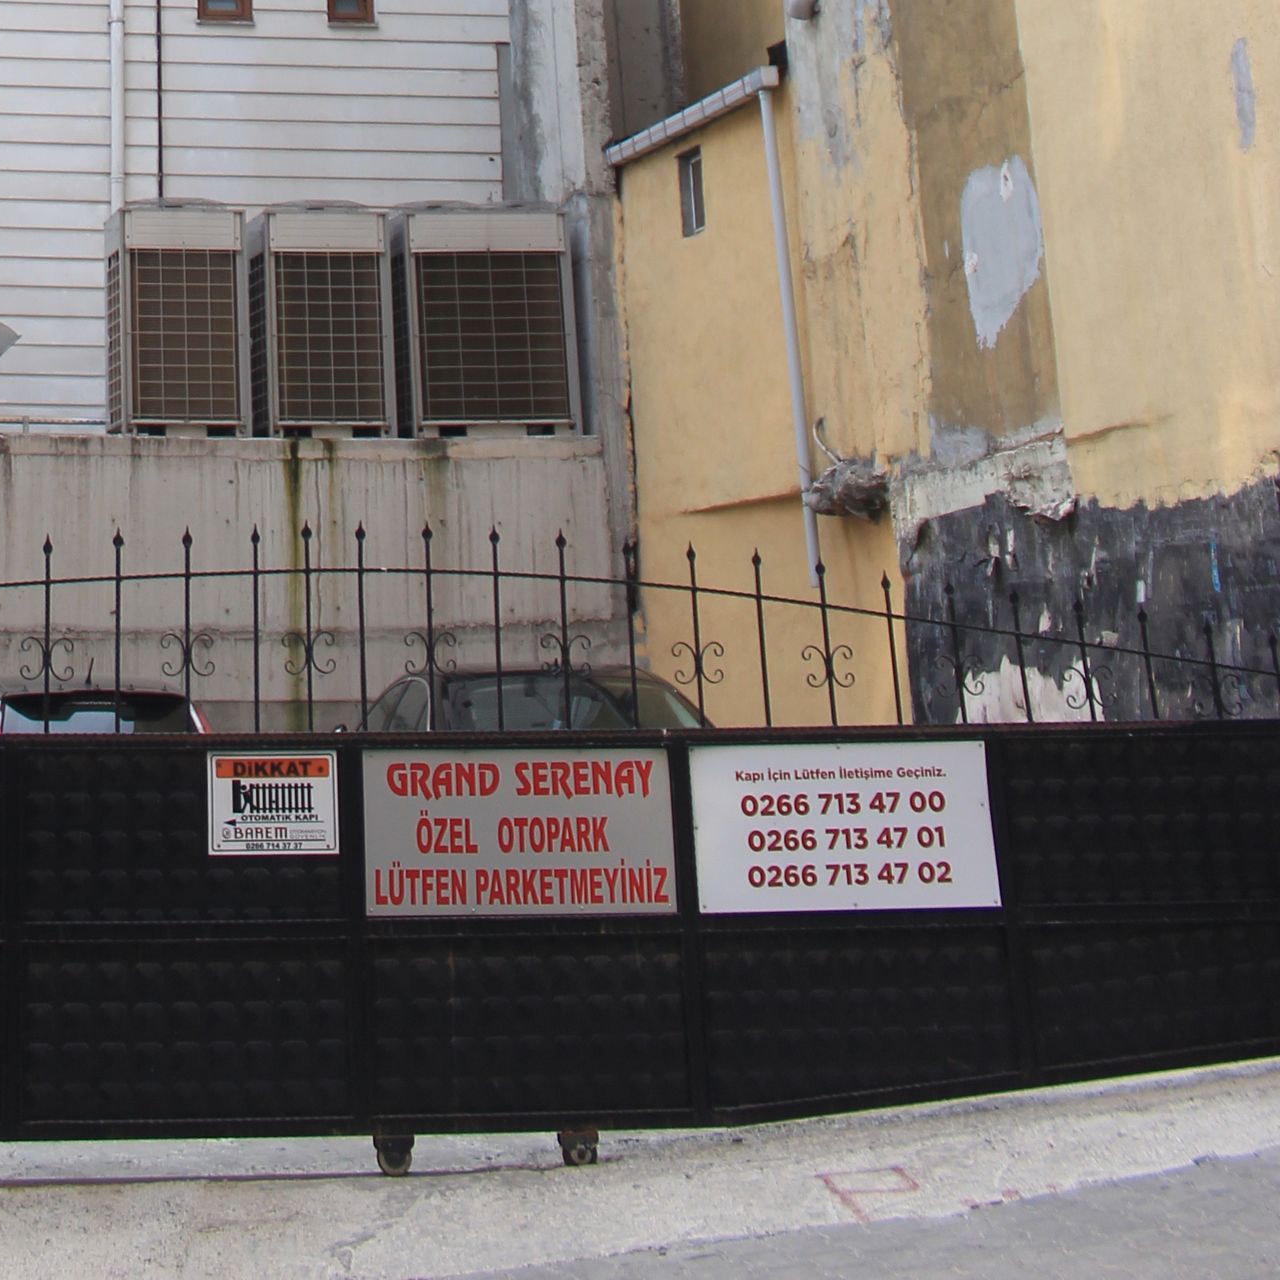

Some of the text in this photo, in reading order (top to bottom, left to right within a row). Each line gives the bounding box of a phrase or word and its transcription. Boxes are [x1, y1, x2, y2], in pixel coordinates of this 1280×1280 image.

[386, 760, 653, 801] GRAND SERENAY
[735, 770, 764, 782] Kapı
[794, 768, 836, 781] Lütfen
[839, 766, 893, 780] İletişime
[896, 766, 947, 779] Geçiniz.
[740, 791, 946, 817] 0266 713 47 00
[234, 827, 288, 839] BAREM
[416, 810, 610, 854] ÖZEL OTOPARK
[747, 826, 946, 853] 0266 713 47 01
[266, 842, 280, 850] 714
[282, 842, 291, 850] 37
[293, 842, 303, 850] 37
[375, 858, 669, 905] LÜTFEN PARKETMEYİNİZ
[747, 861, 953, 888] 0266 713 47 02
